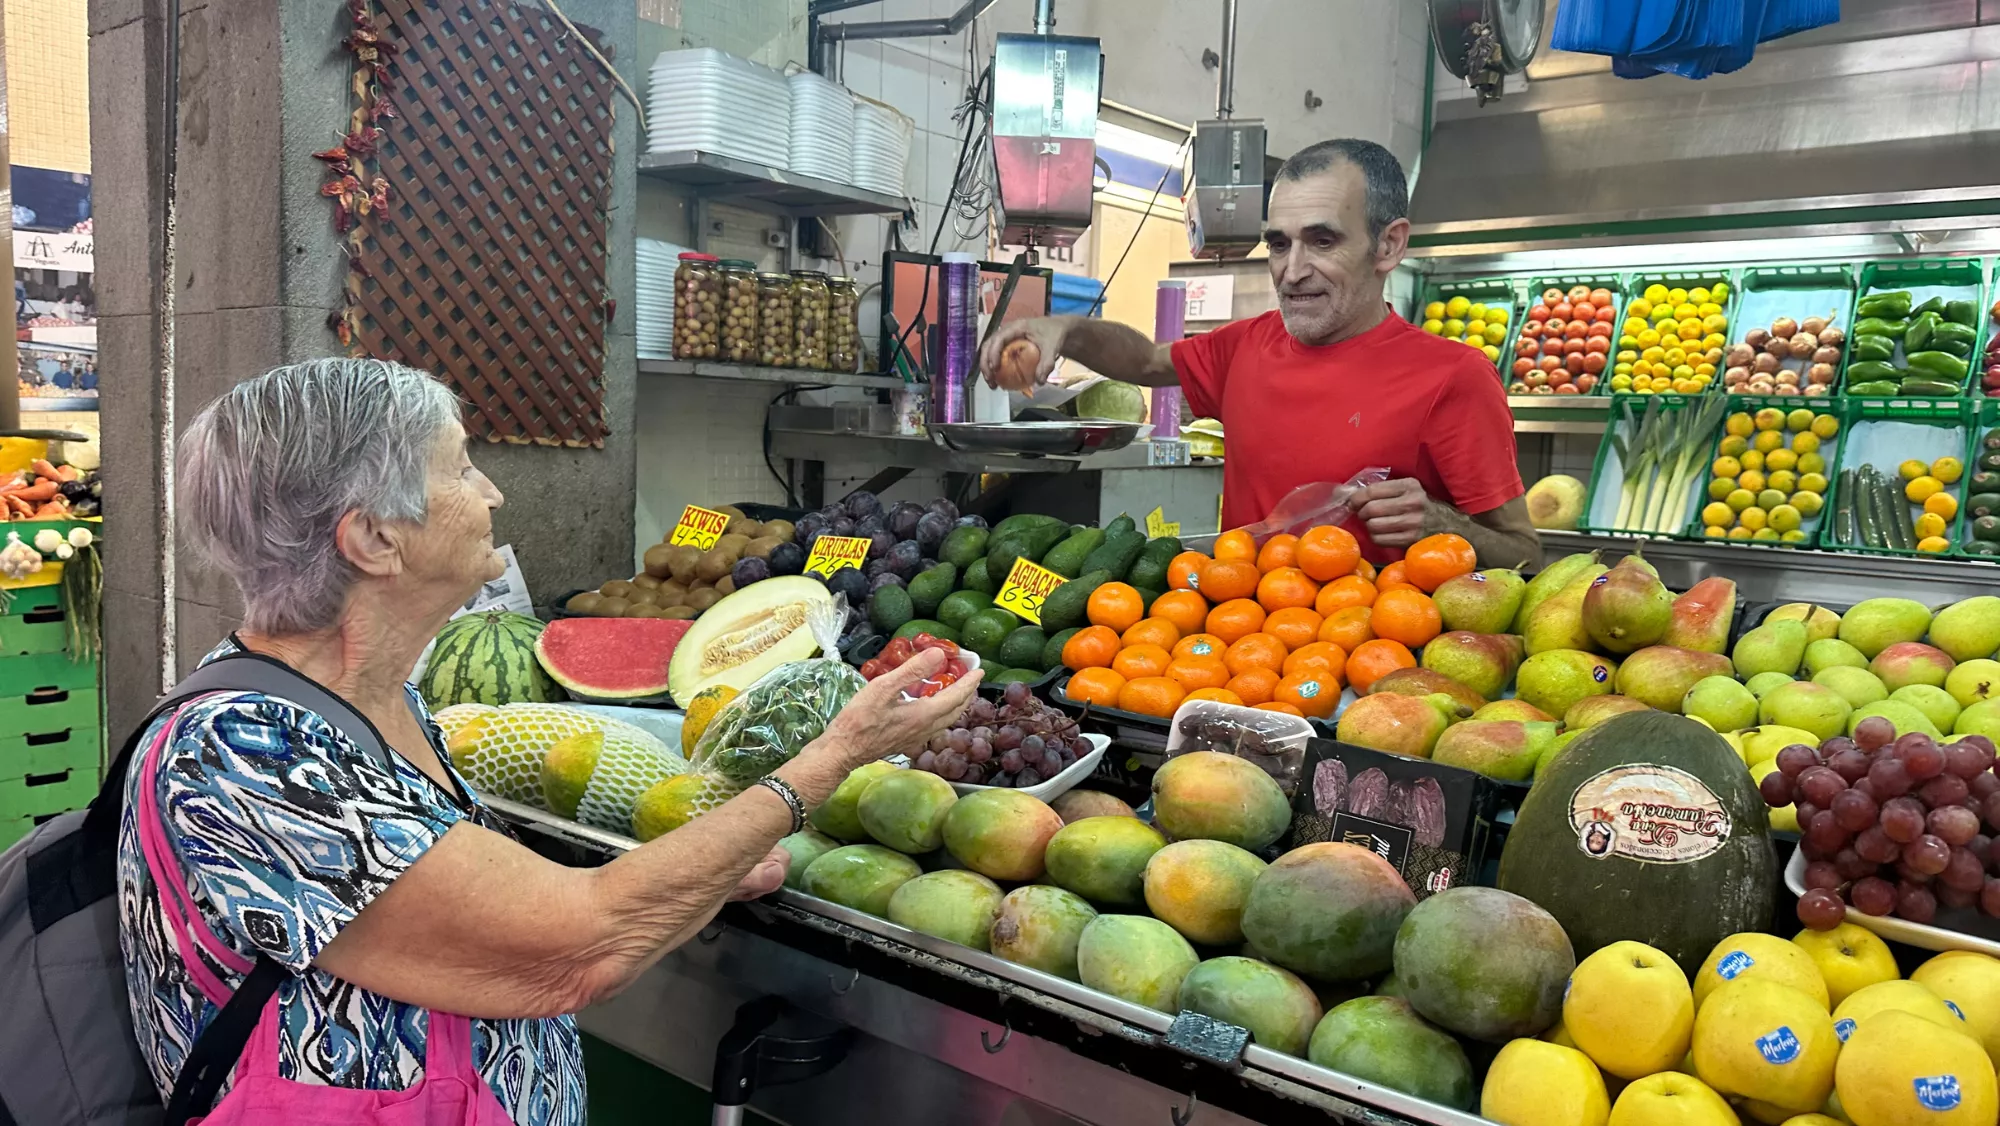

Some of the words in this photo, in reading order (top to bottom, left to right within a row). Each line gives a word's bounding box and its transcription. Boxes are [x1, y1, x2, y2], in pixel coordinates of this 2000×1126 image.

[679, 506, 727, 535] KIWIS
[813, 536, 868, 560] CIRUELAS
[1620, 802, 1728, 838] Ramoncita
[1629, 819, 1678, 848] Doña
[1762, 1036, 1796, 1059] Marlene
